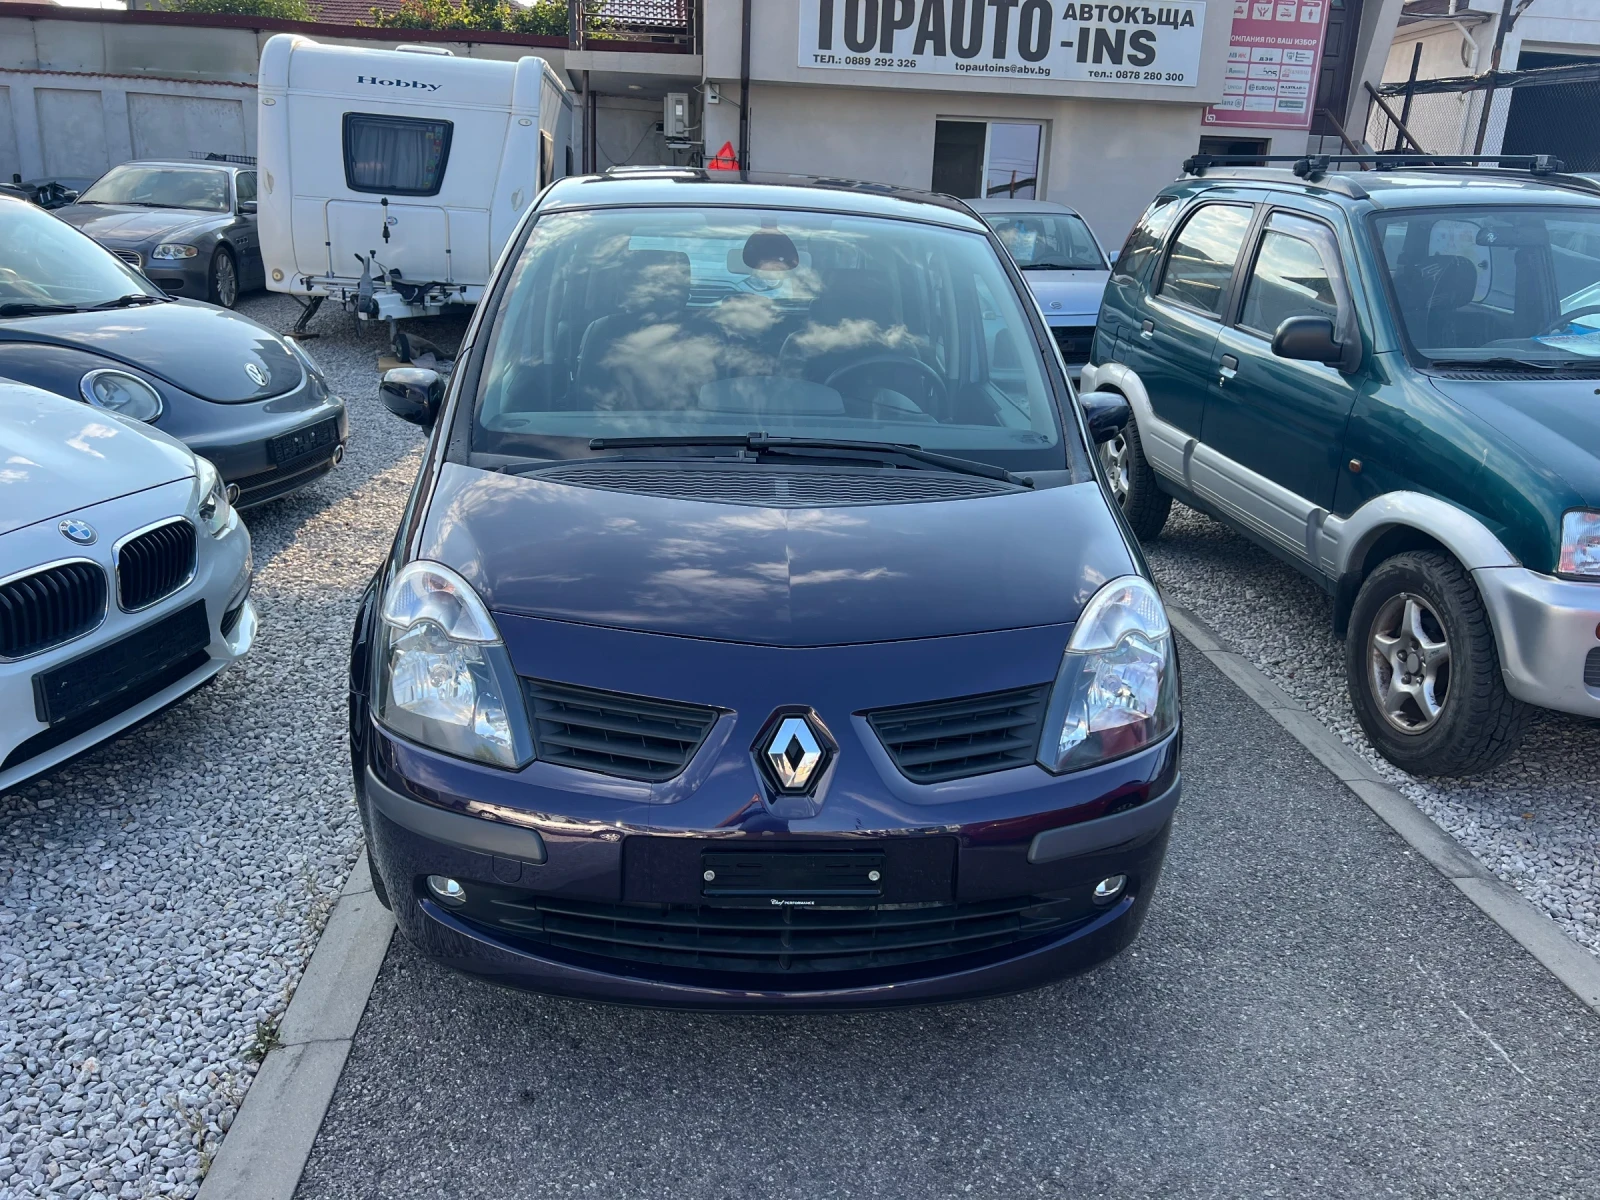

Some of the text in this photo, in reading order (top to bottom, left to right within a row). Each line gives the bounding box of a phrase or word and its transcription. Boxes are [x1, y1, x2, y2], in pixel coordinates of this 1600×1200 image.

[1062, 3, 1195, 30] АВТОКЪЩА
[818, 0, 1053, 63] TOPAUTO
[1230, 35, 1317, 47] ОМПАНИЯ ПО ВАШ ИЗБОР
[813, 54, 917, 68] ТЕЛ.: 0889 292 326
[955, 62, 1051, 76] topautoins@abv.bg
[1088, 70, 1184, 82] тел.: 0878 280 300
[356, 76, 443, 92] Hobby
